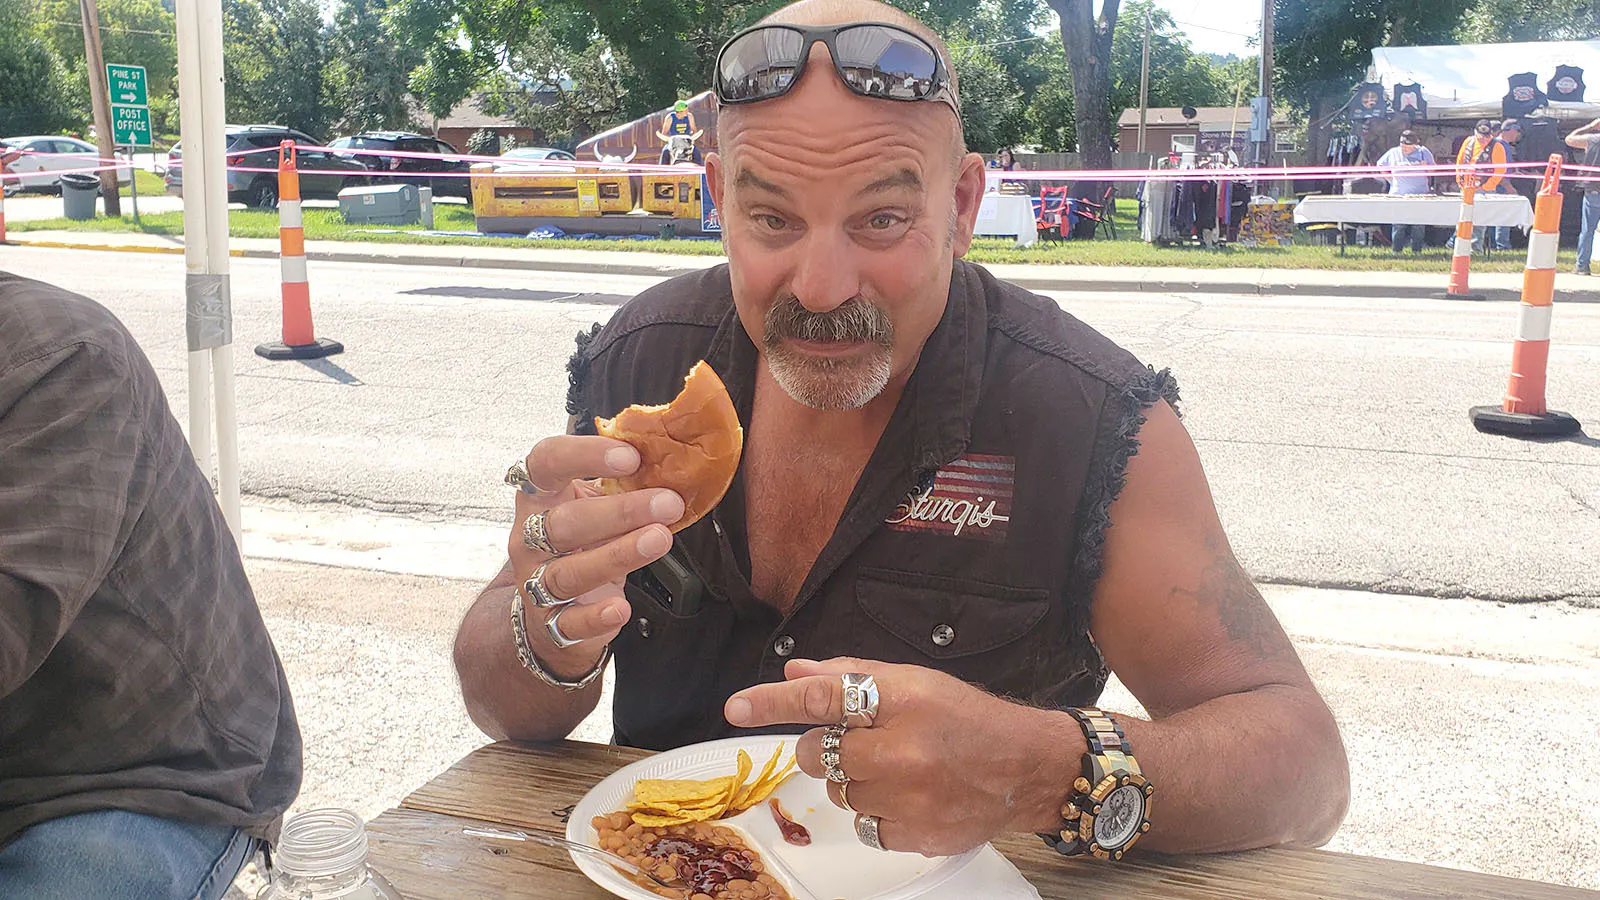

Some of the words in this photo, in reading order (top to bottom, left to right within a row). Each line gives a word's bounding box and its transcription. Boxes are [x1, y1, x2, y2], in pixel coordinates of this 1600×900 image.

[112, 69, 129, 79] PINE
[131, 71, 140, 80] ST
[118, 81, 137, 90] PARK
[120, 108, 141, 119] POST
[117, 120, 146, 131] OFFICE
[884, 485, 1010, 536] Sturgis
